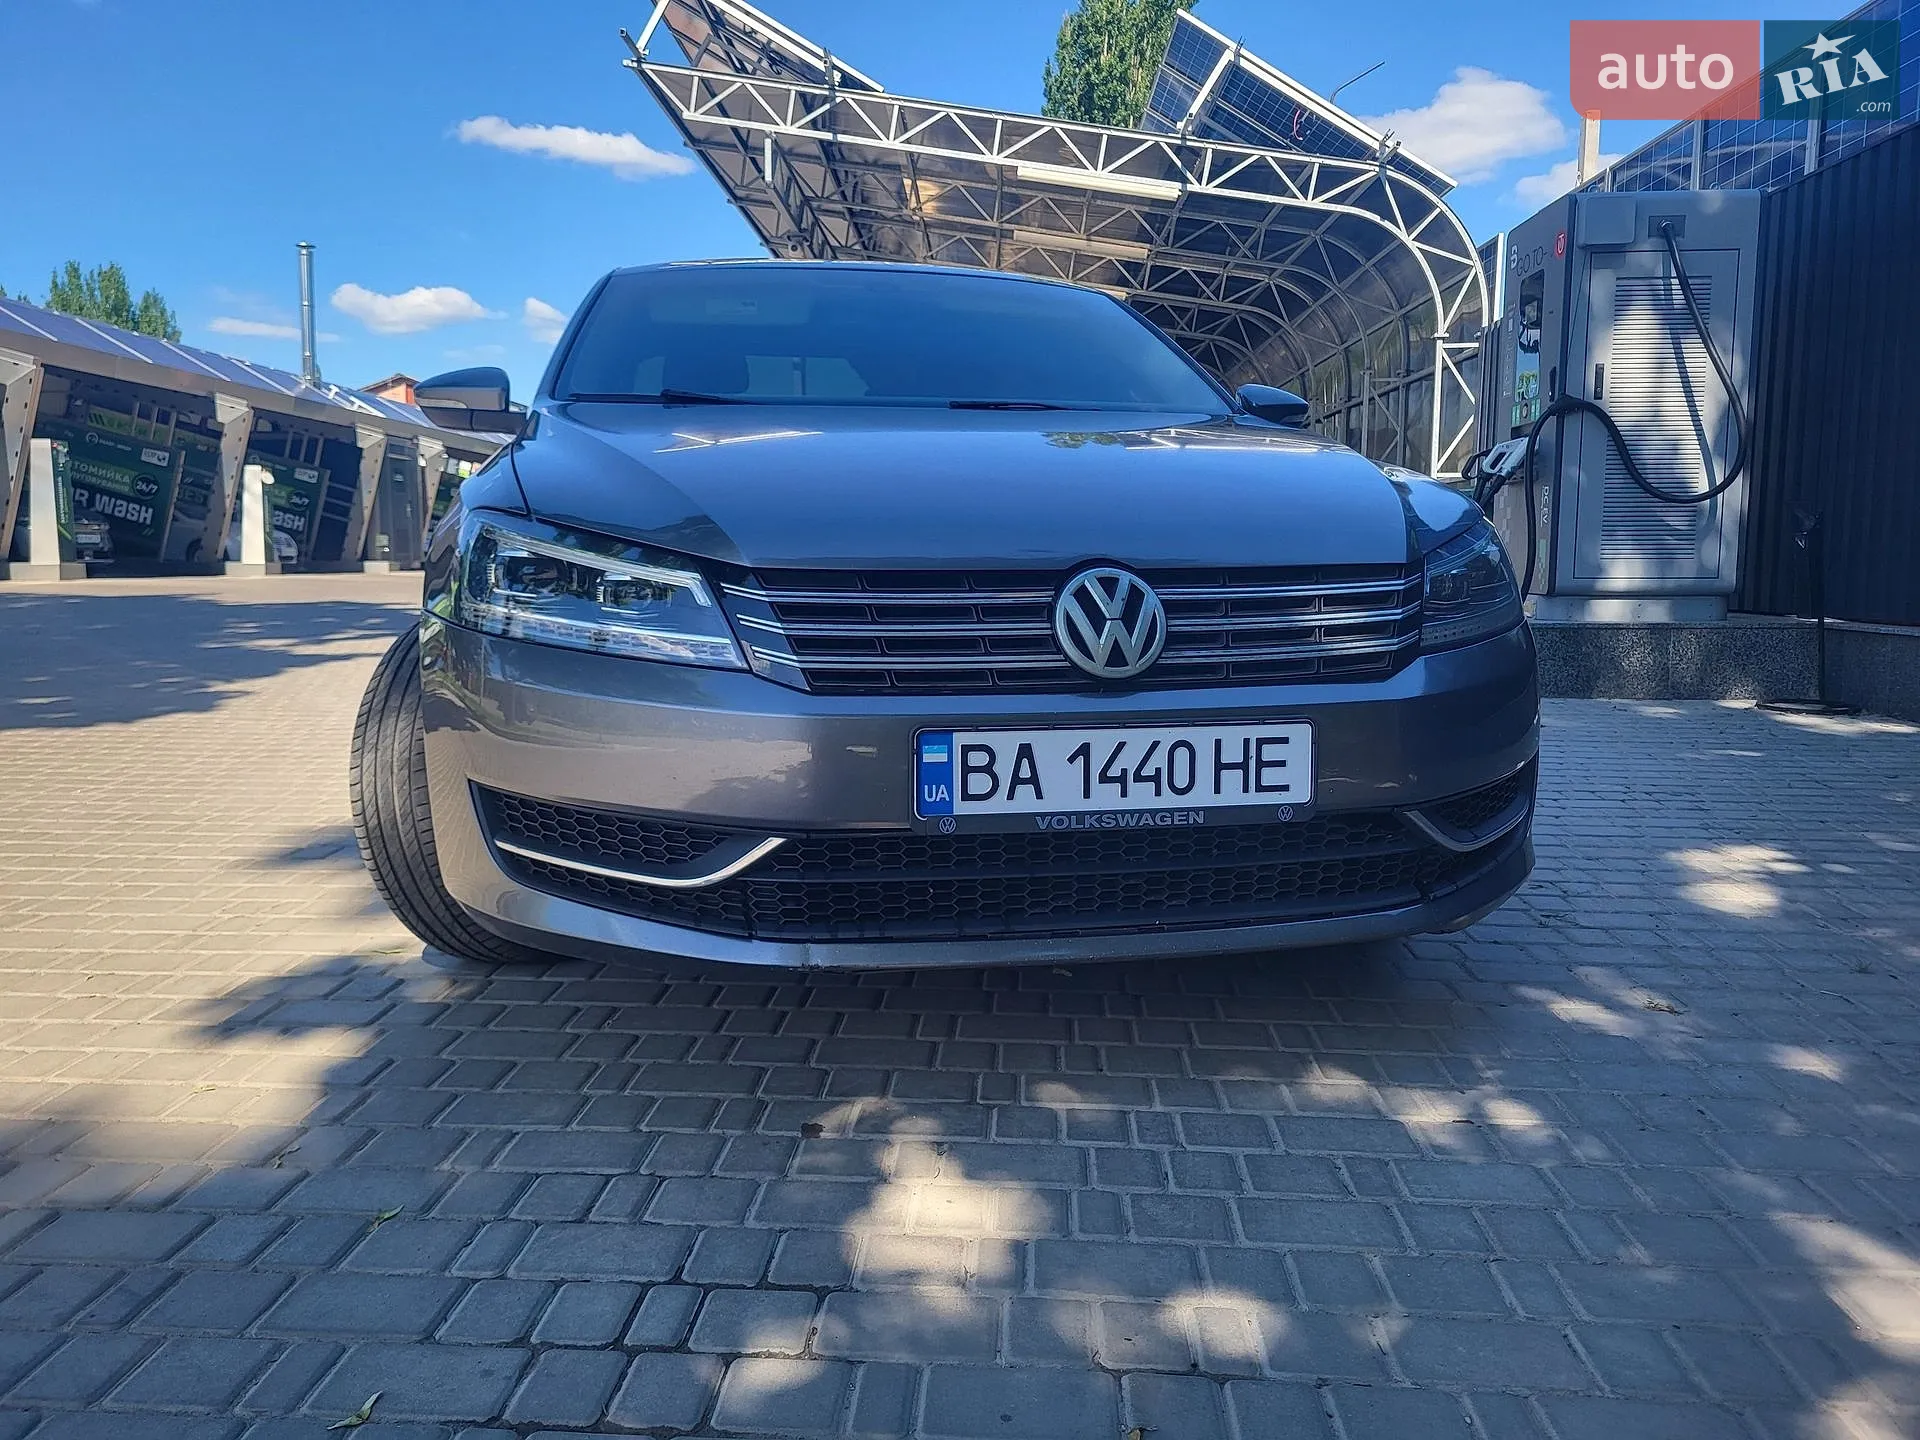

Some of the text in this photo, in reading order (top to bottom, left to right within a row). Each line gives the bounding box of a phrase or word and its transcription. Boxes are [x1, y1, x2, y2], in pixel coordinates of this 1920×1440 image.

[73, 460, 131, 483] ТОМИЙКА
[135, 480, 158, 493] 24/7
[960, 736, 1290, 802] BA 1440 HE
[924, 784, 950, 802] UA
[1035, 810, 1205, 830] VOLKSWAGEN
